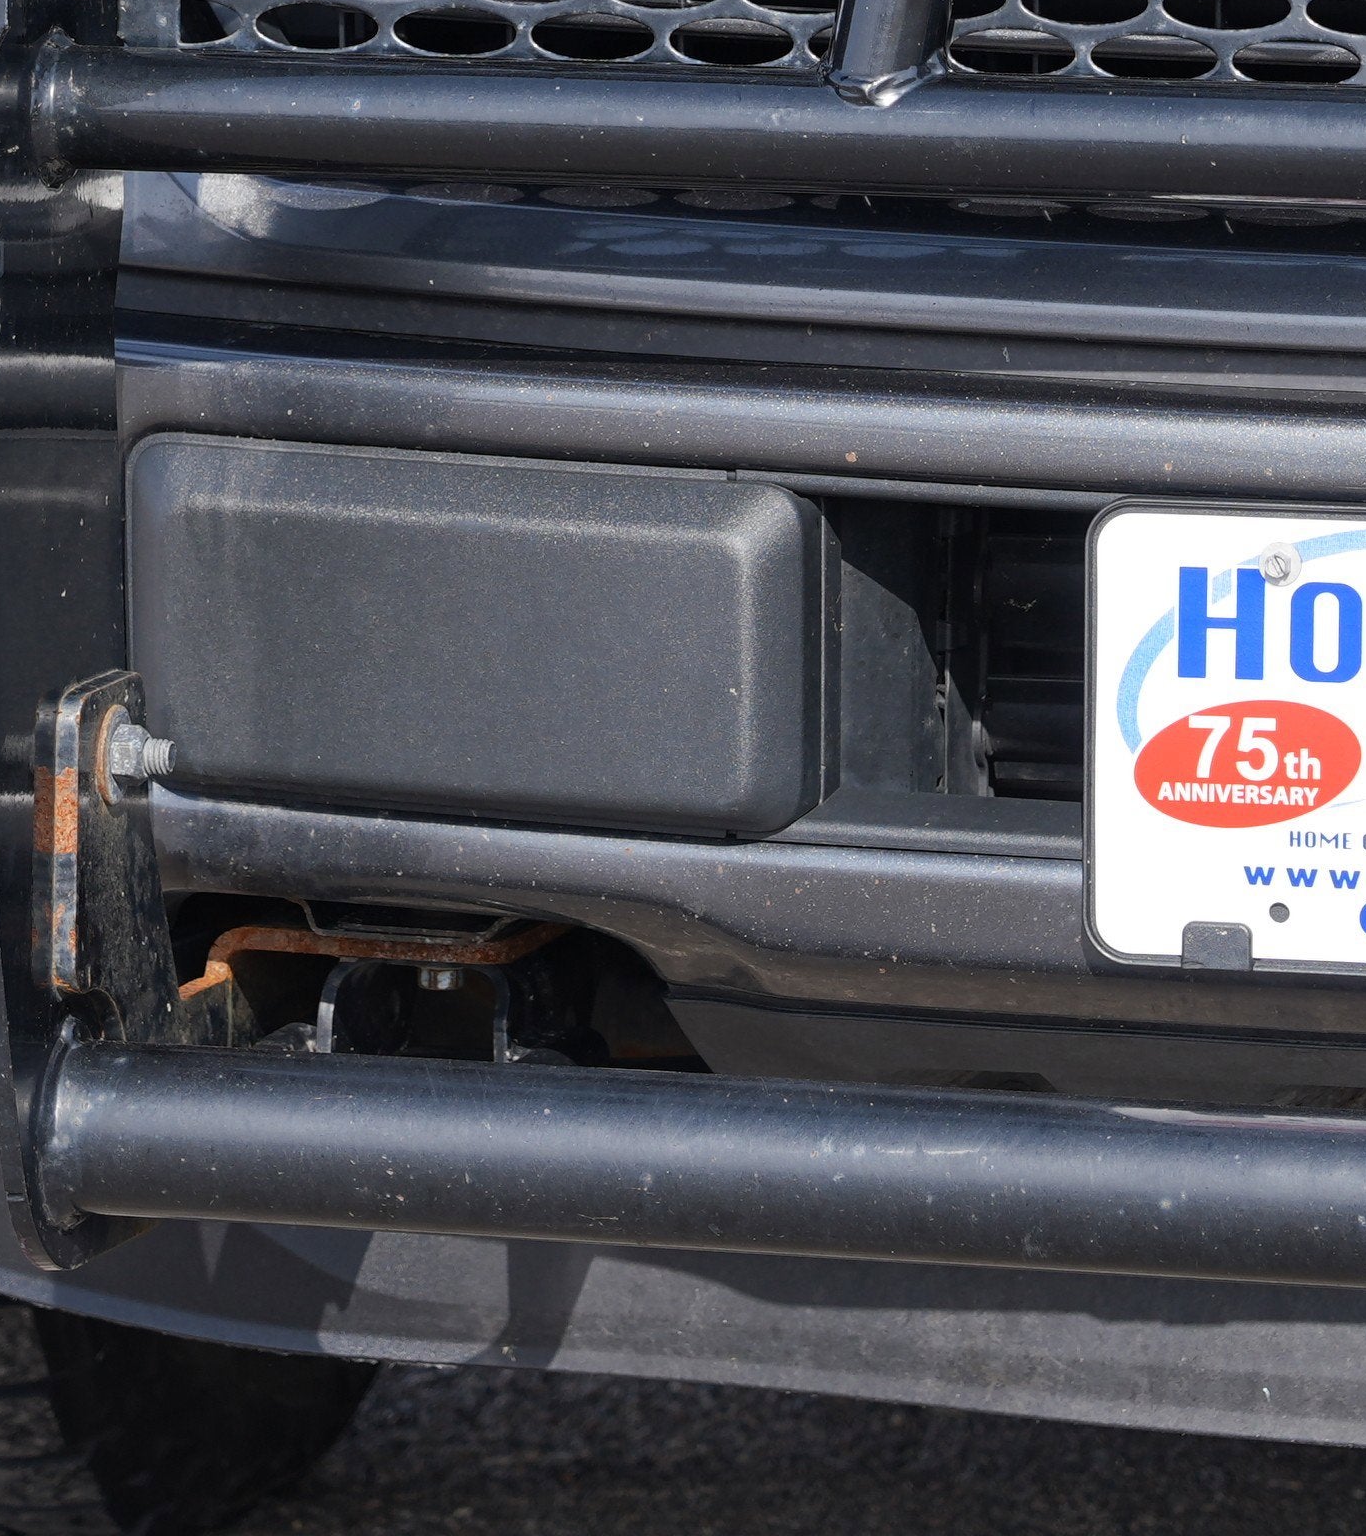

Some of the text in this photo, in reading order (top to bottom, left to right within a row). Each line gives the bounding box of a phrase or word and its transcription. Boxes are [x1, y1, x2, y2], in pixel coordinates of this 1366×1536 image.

[1187, 716, 1322, 782] 75th
[1157, 781, 1320, 810] ANNIVERSARY
[1288, 830, 1352, 850] HOME
